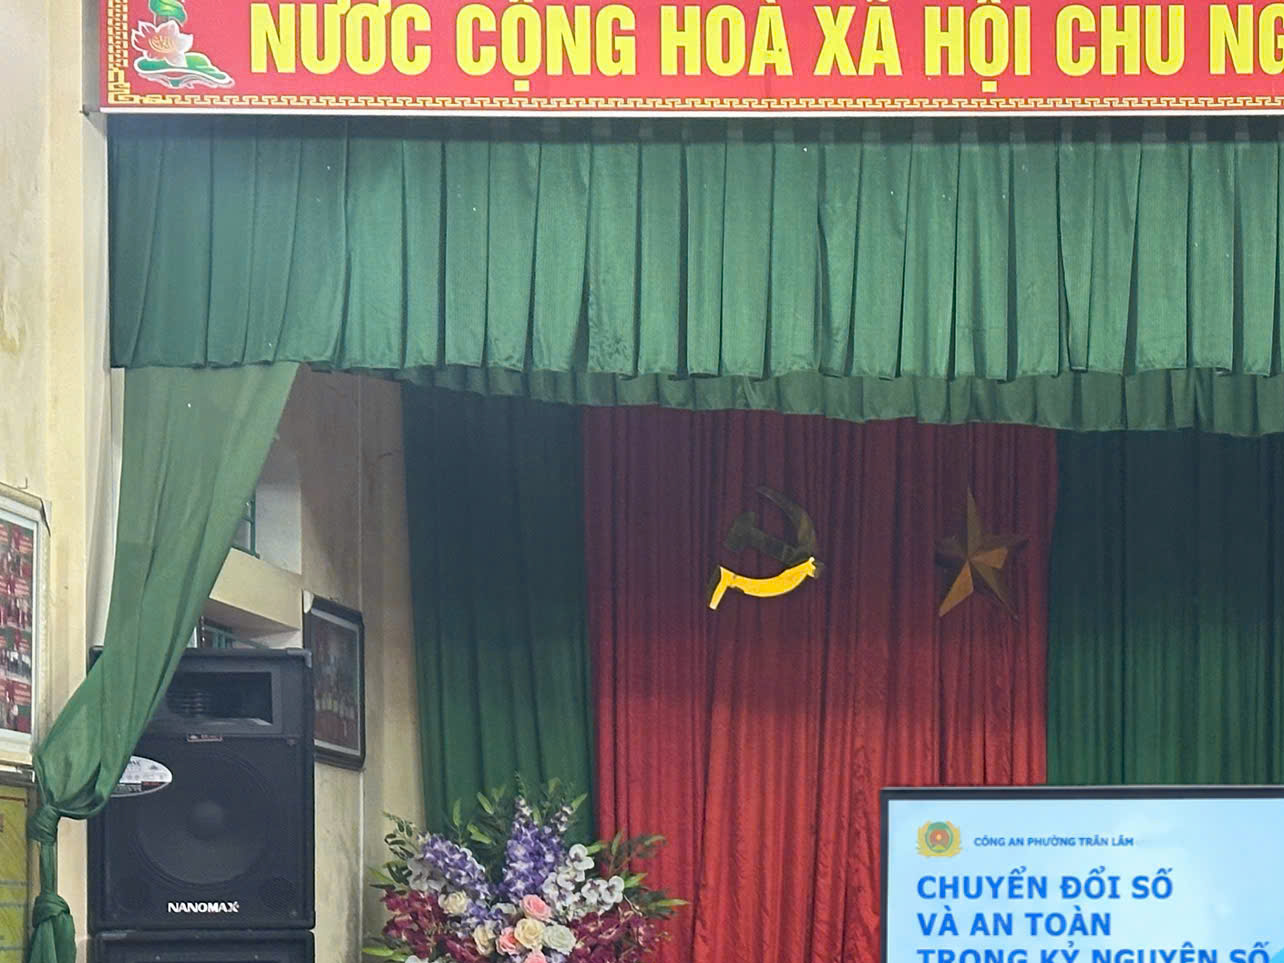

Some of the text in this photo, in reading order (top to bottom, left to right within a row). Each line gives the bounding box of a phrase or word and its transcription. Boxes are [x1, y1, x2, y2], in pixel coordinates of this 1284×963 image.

[1008, 837, 1024, 847] AN
[917, 865, 1173, 900] CHUYỂN ĐỔI SỐ
[167, 900, 240, 913] NANOMAX
[917, 905, 1111, 936] VÀ AN TOÀN
